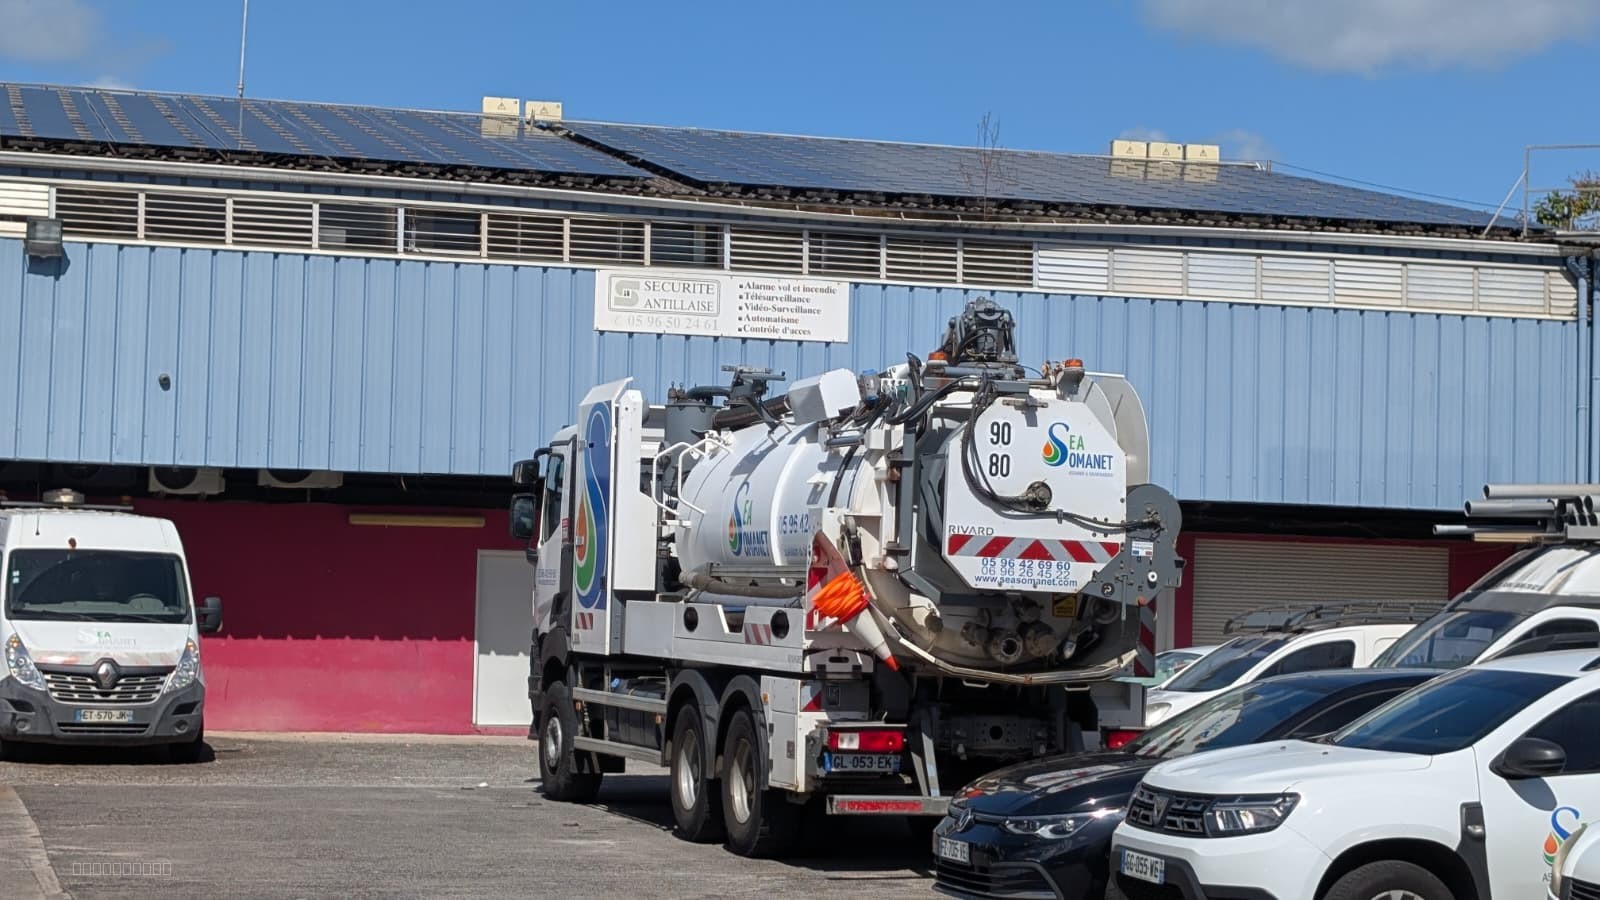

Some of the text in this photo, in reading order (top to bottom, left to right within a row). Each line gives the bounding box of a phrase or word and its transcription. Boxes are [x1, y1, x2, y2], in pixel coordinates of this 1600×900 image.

[644, 281, 715, 295] SECURITE
[744, 281, 776, 291] Alarme
[802, 285, 837, 294] incendie
[744, 292, 811, 303] Télésurveillance
[644, 298, 714, 312] ANTILLAISE
[744, 302, 821, 315] Vidéo-Surveillance
[628, 315, 718, 330] 05 96 50 24 61
[744, 314, 800, 324] Automatisme
[743, 324, 780, 334] Contrôle
[990, 421, 1012, 446] 90
[988, 453, 1011, 477] 80
[789, 514, 798, 534] 96
[949, 524, 994, 536] RIVARD
[981, 557, 1071, 571] 05 96 42 69 60
[981, 566, 1070, 580] 06 96 26 45 22
[975, 575, 1078, 587] www.seasomanet.com
